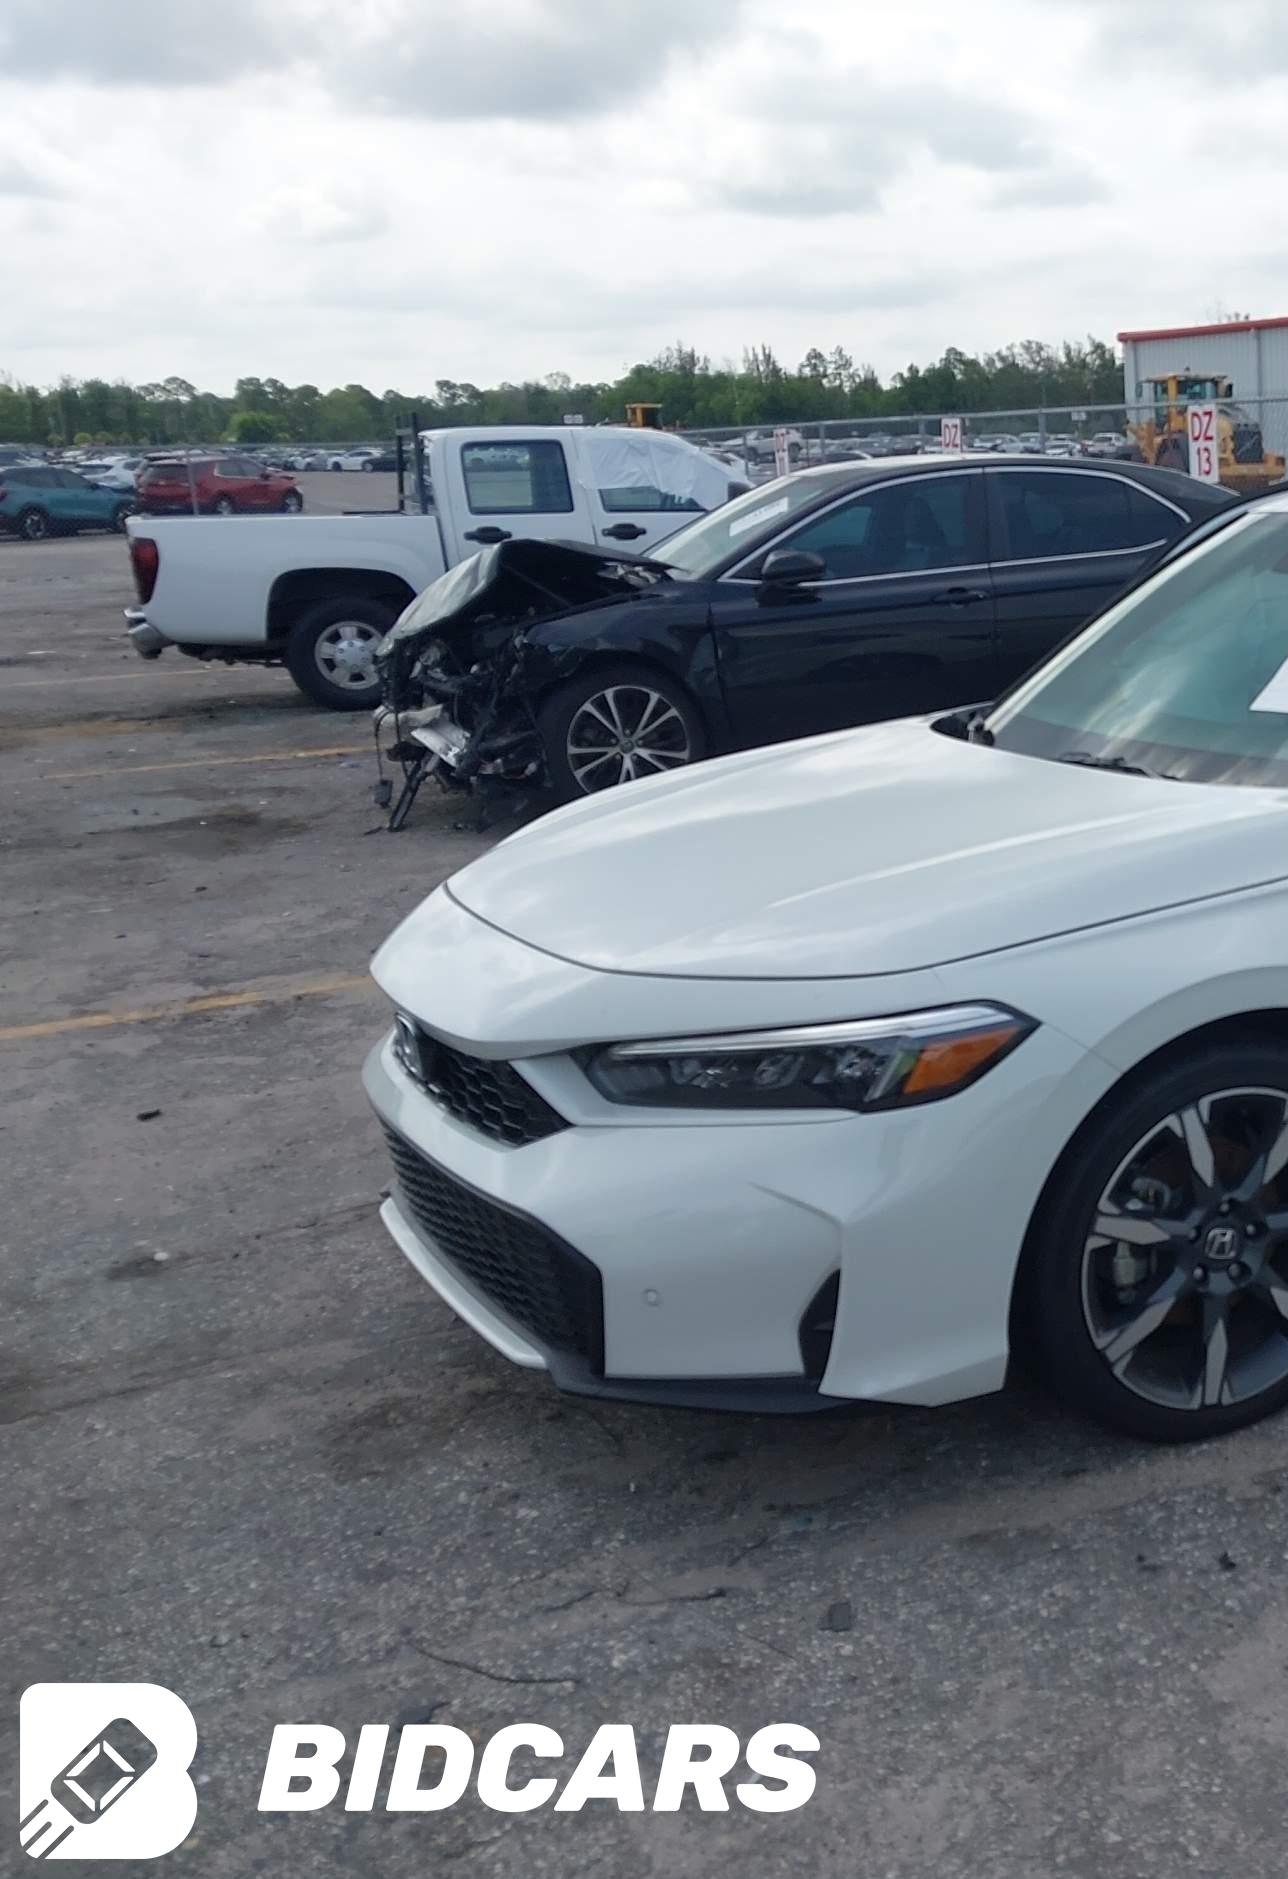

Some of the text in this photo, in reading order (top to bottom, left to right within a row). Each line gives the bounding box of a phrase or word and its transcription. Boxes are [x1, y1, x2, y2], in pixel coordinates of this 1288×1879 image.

[943, 424, 959, 448] DZ
[1191, 411, 1213, 441] DZ
[1197, 447, 1212, 476] 13
